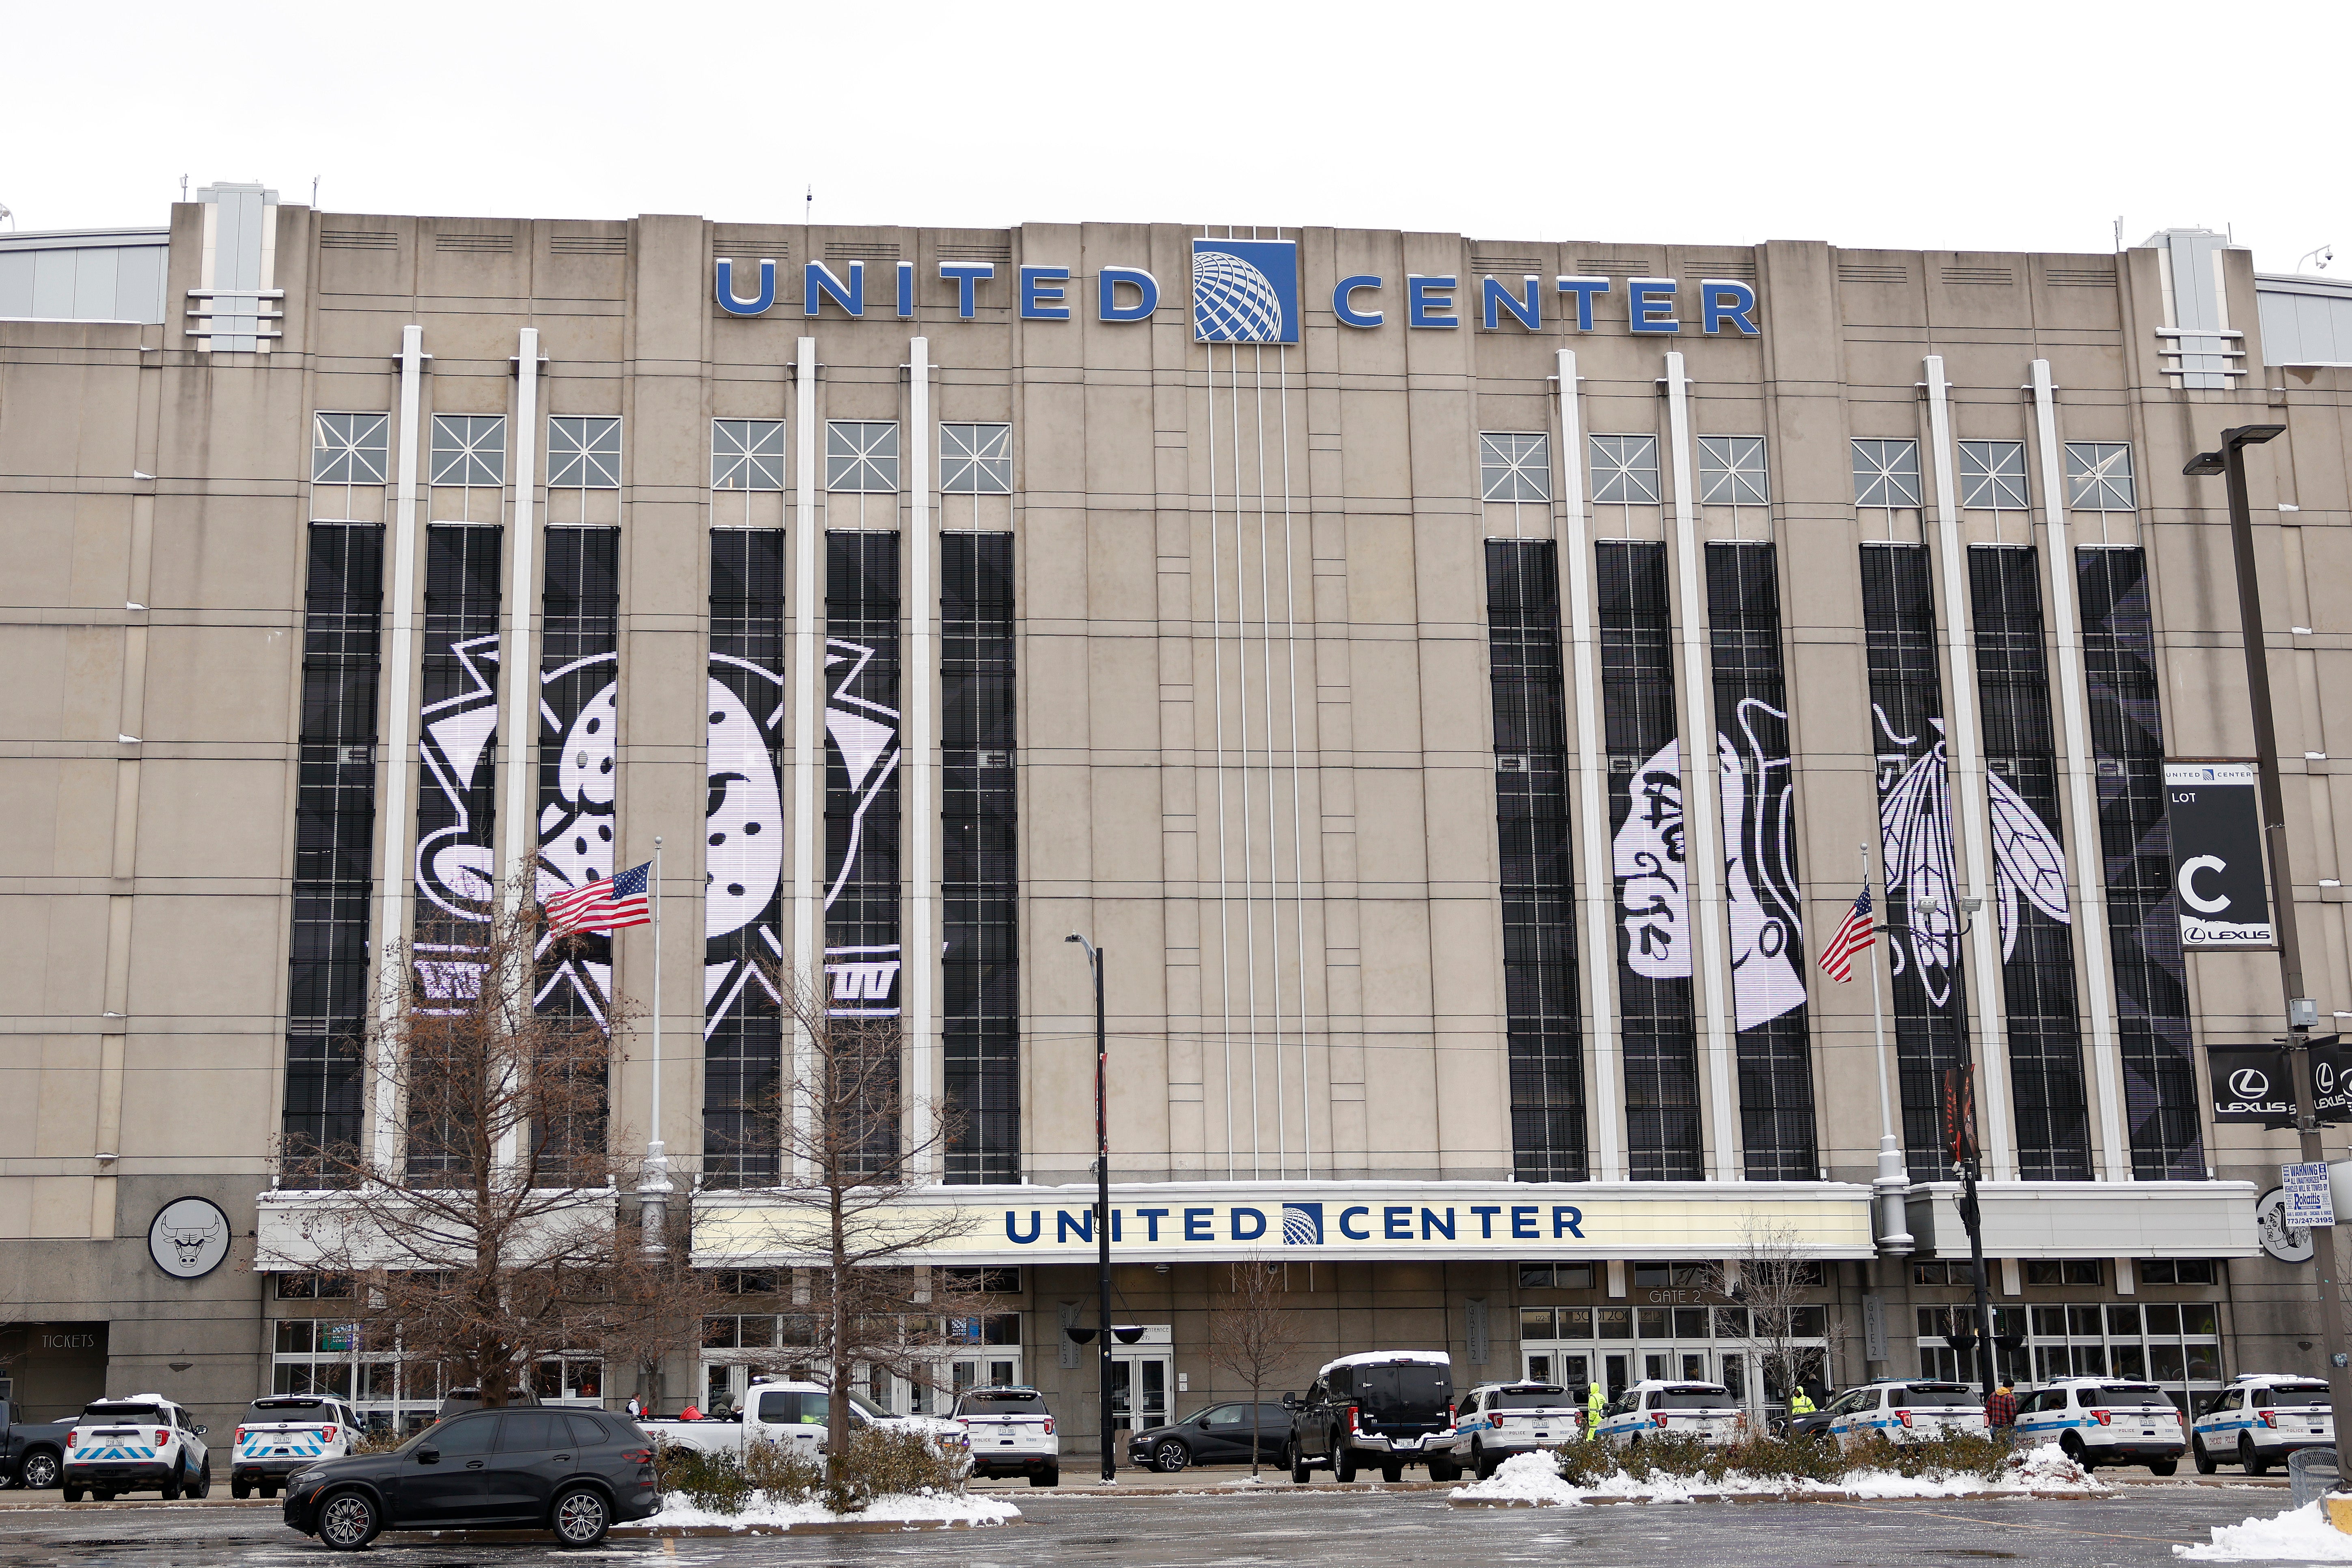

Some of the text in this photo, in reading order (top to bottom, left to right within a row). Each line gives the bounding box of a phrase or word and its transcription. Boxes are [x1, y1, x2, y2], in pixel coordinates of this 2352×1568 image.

[715, 260, 1761, 334] UNITED CENTER
[2172, 793, 2196, 802] LOT
[2178, 854, 2231, 913] C
[2208, 930, 2270, 940] LEXUS
[2313, 1094, 2346, 1110] LEXUS
[2216, 1102, 2287, 1113] LEXUS
[2290, 1164, 2318, 1176] WARNING
[2297, 1176, 2320, 1184] UNAUTHORIZED
[2294, 1193, 2320, 1210] Rokaitis
[1006, 1206, 1586, 1244] UNITED CENTER
[1649, 1290, 1701, 1303] GATE 2
[42, 1335, 94, 1348] TICKETS
[1472, 1350, 1476, 1359] 2
[1872, 1346, 1877, 1355] 2
[1063, 1354, 1067, 1363] 3
[1075, 1354, 1078, 1363] 3
[2041, 1435, 2057, 1444] POLICE
[2209, 1435, 2236, 1445] CHICAGO POLICE
